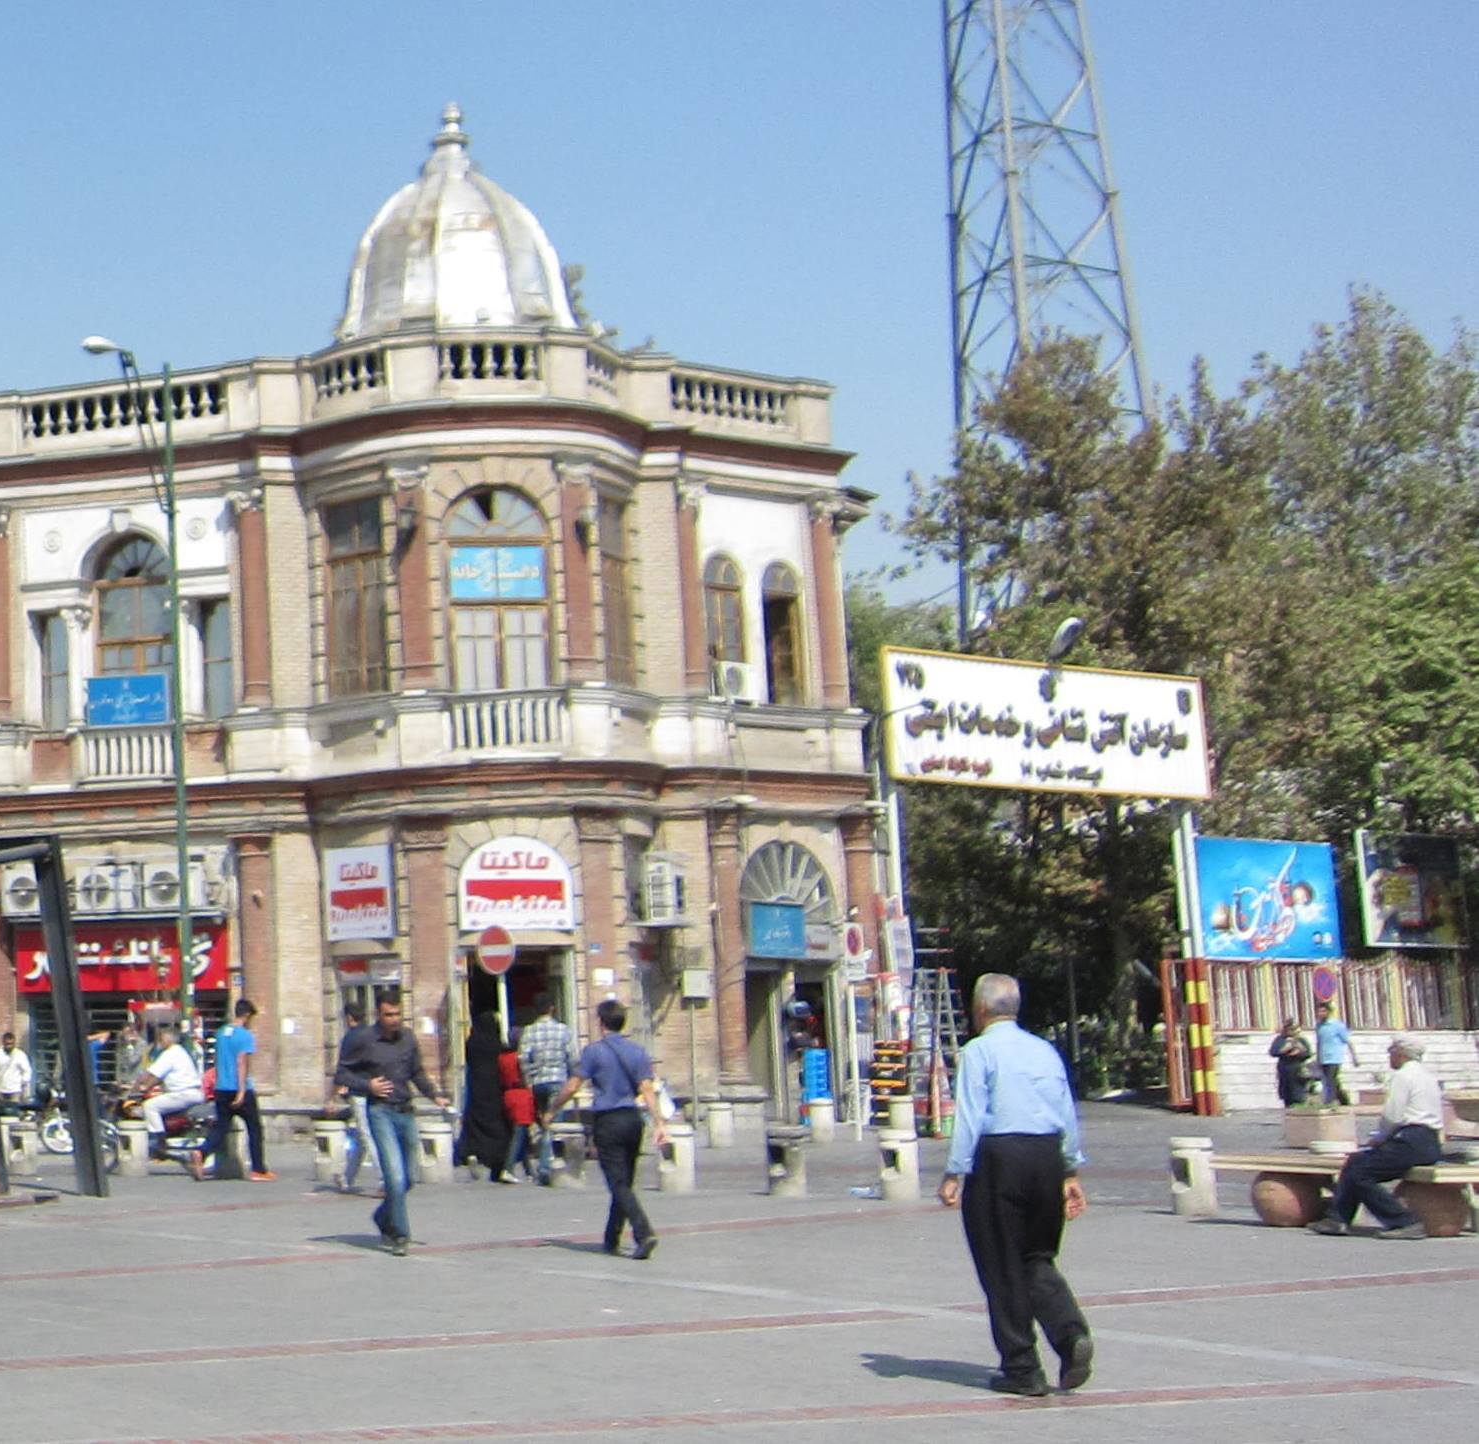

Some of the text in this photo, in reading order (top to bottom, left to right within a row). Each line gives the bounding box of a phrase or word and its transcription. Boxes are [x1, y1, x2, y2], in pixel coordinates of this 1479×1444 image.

[1023, 720, 1034, 748] و
[1036, 706, 1087, 749] نشانی
[1090, 709, 1128, 753] آتش
[1129, 717, 1187, 758] سازمان
[479, 851, 550, 875] ماکیتا
